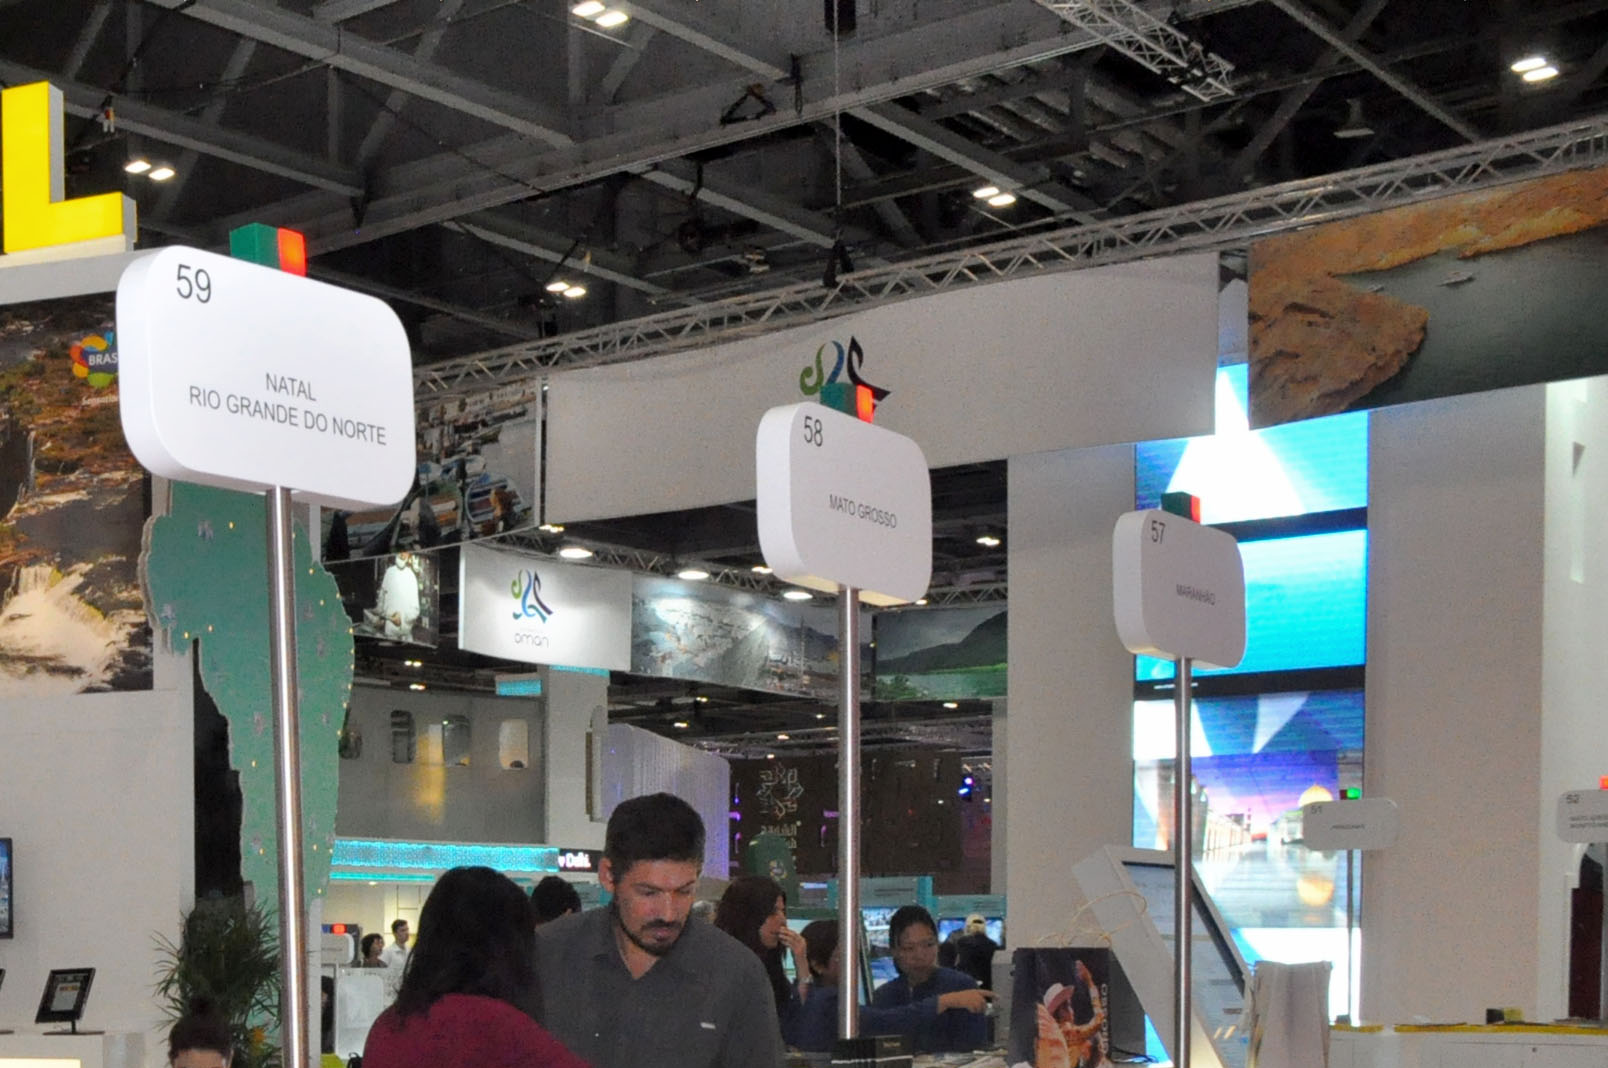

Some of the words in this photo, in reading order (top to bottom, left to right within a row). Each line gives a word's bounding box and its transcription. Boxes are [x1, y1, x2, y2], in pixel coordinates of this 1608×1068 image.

[175, 263, 212, 304] 59
[88, 352, 118, 366] BRAS
[265, 372, 317, 402] NATAL
[188, 385, 221, 411] RIO
[226, 393, 299, 428] GRANDE
[304, 409, 328, 432] DO
[332, 416, 388, 446] NORTE
[803, 415, 823, 447] 58
[829, 494, 856, 516] MATO
[857, 503, 897, 529] GROSSO
[1151, 520, 1166, 545] 57
[514, 632, 550, 648] oman
